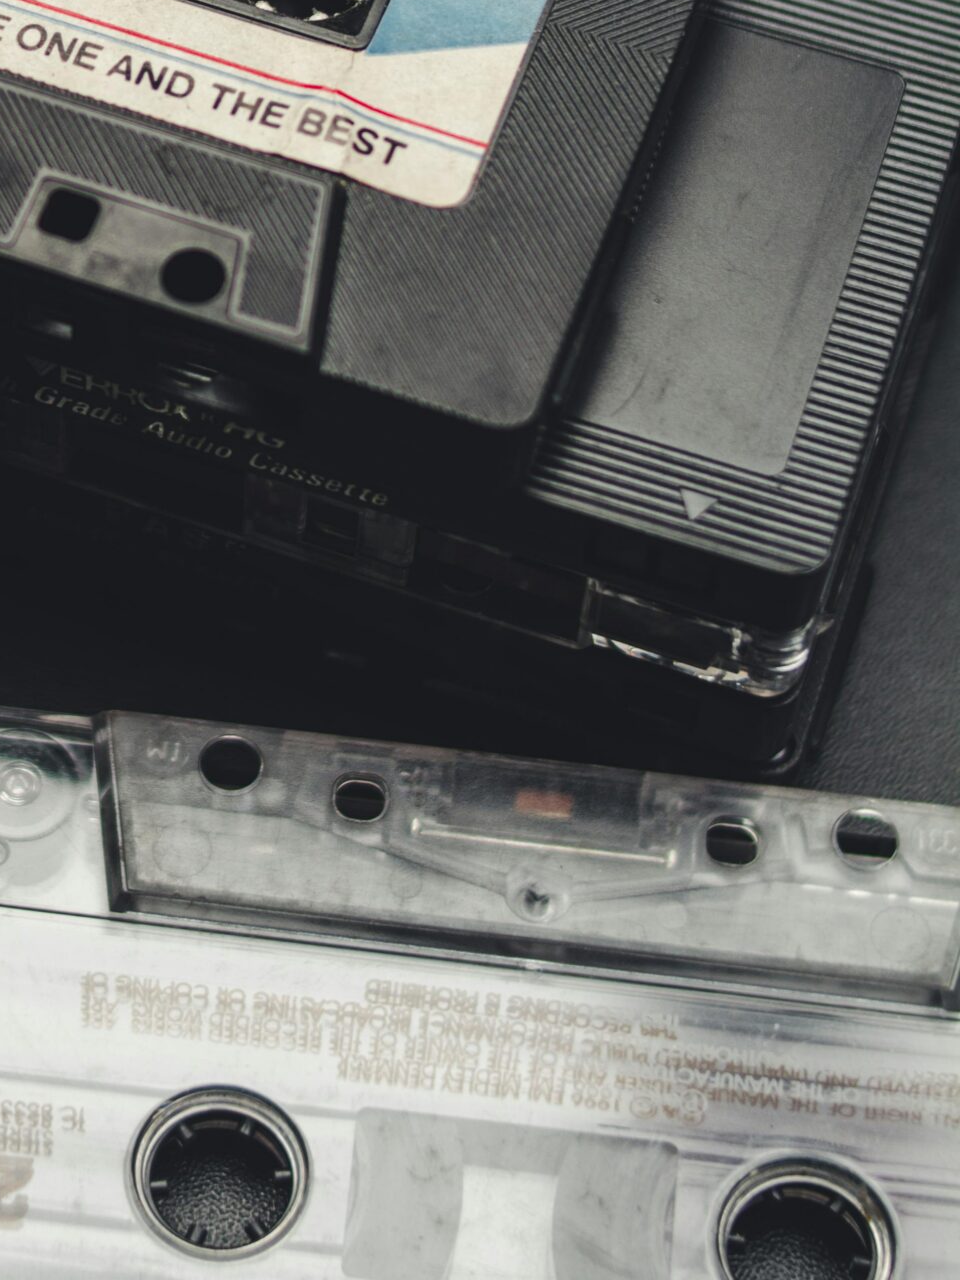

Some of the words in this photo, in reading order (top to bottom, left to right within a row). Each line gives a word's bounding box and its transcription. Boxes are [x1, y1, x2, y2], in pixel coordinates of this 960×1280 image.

[16, 23, 104, 71] ONE
[107, 55, 195, 99] AND
[212, 83, 289, 129] THE
[297, 107, 408, 166] BEST
[34, 385, 127, 426] Grade
[142, 420, 233, 460] Audio
[249, 452, 389, 507] Cassette
[115, 974, 209, 1010] COPYING
[365, 978, 478, 1014] PROHIBITED
[132, 1002, 204, 1041] WORKS
[209, 1012, 321, 1053] RECORDED
[252, 991, 415, 1035] BROADCASTING
[420, 1012, 574, 1052] PERFORMANCE
[507, 995, 632, 1034] RECORDING
[405, 1034, 481, 1066] OWNER
[338, 1054, 435, 1089] DENMARK
